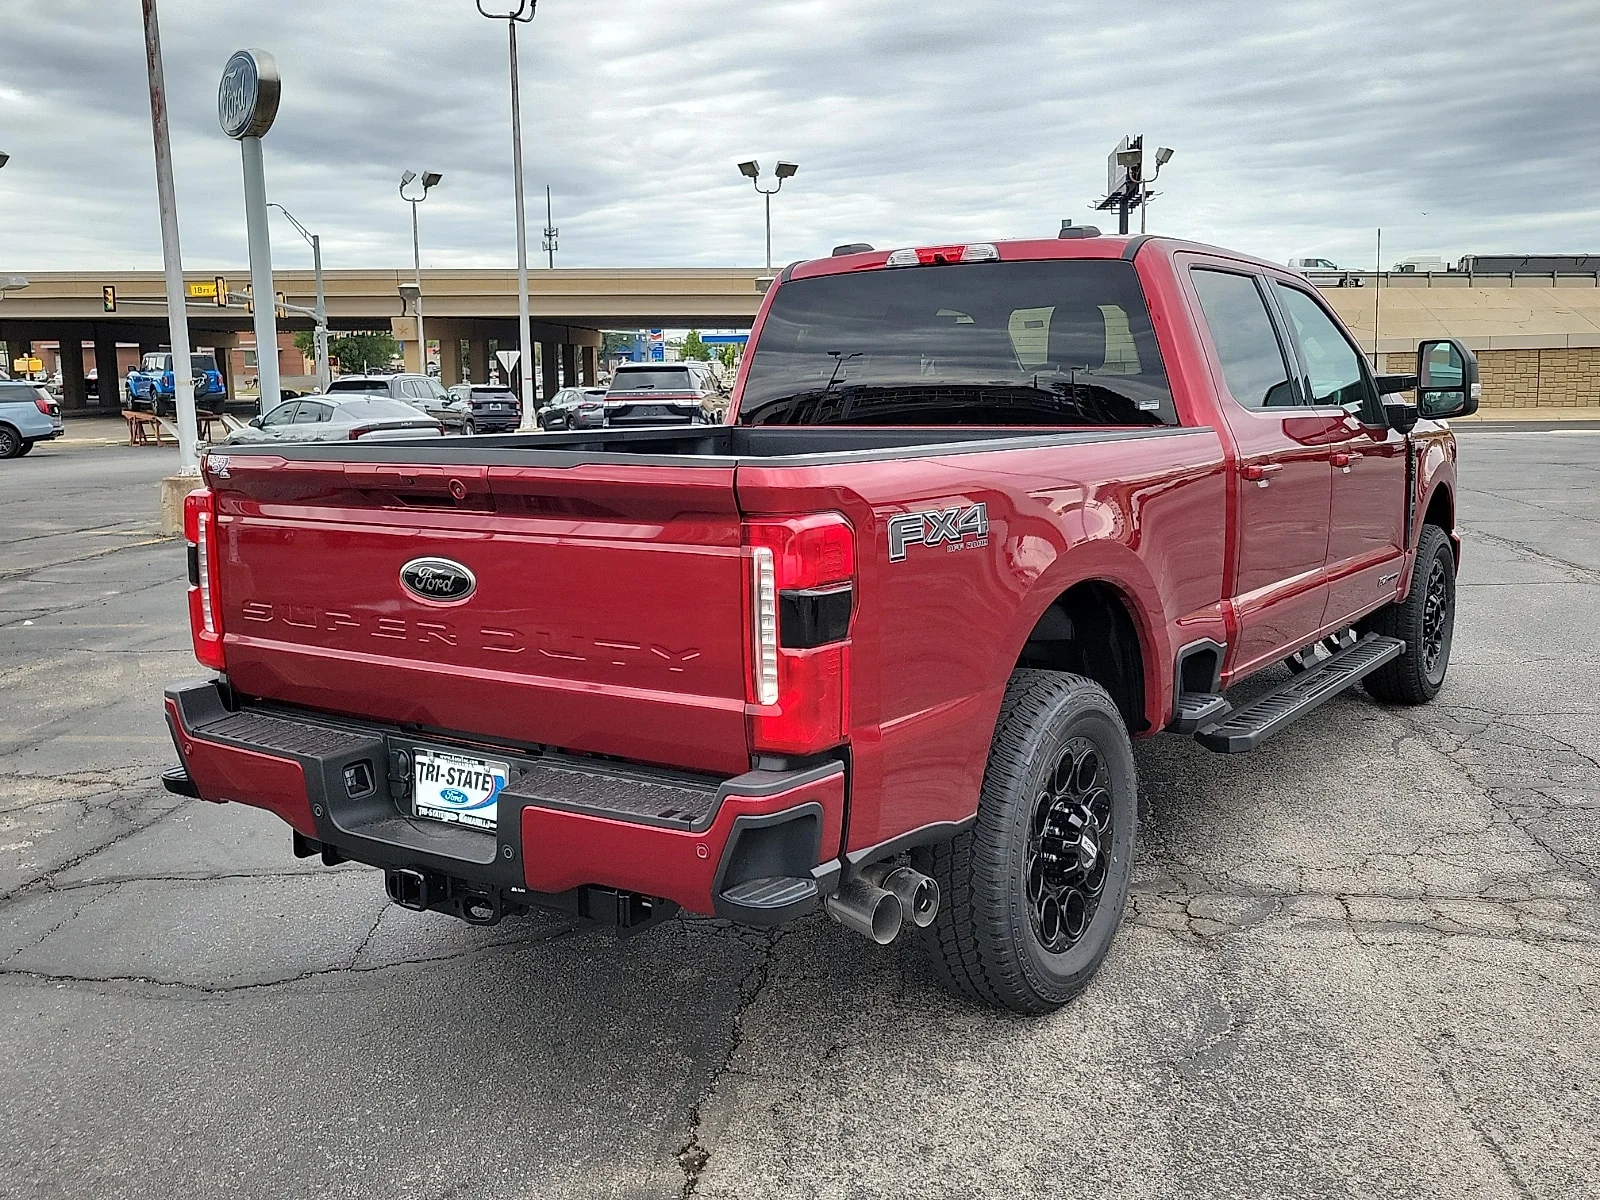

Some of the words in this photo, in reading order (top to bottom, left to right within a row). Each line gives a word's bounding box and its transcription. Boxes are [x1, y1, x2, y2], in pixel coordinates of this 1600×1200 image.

[221, 67, 247, 123] Ford
[887, 502, 989, 563] FX4
[414, 566, 456, 593] Ford
[241, 601, 458, 647] SUPER
[479, 628, 701, 672] DUTY
[416, 761, 492, 792] TRI-STATE
[444, 790, 464, 802] Ford
